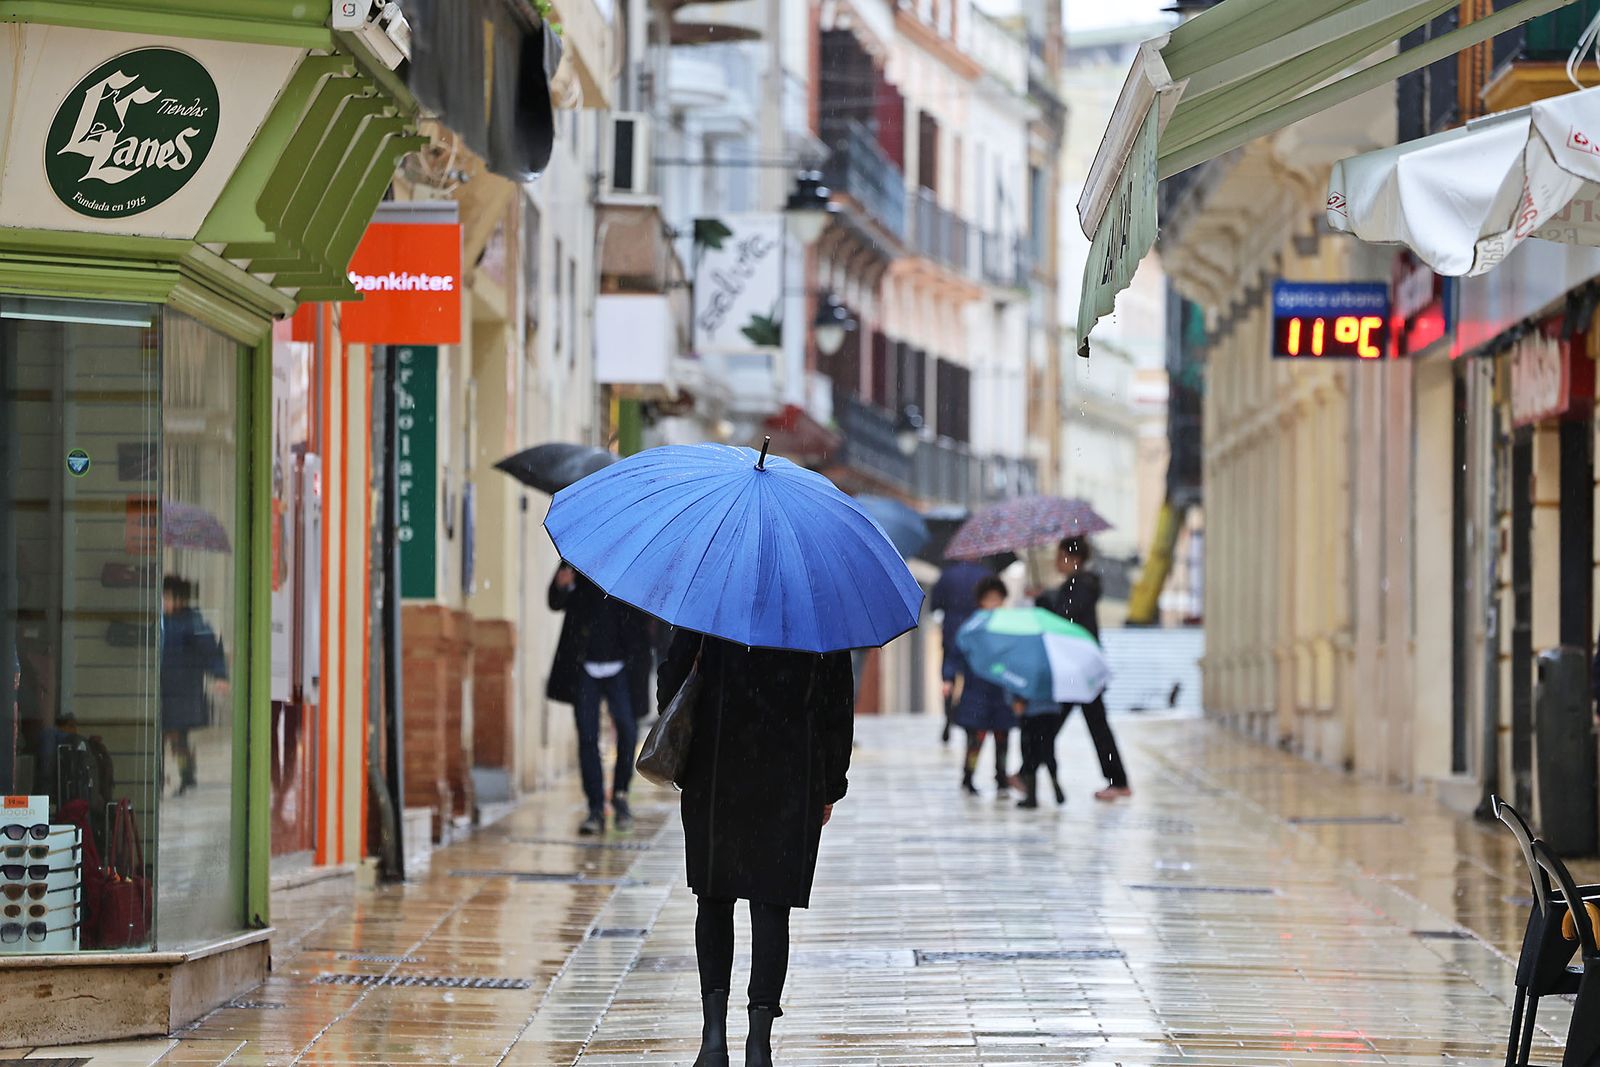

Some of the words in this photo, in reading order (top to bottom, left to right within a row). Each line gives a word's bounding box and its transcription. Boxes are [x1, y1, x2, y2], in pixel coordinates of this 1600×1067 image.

[156, 97, 208, 118] Tiendas
[72, 191, 110, 212] Fundada
[111, 204, 124, 212] en
[126, 196, 147, 210] 1915
